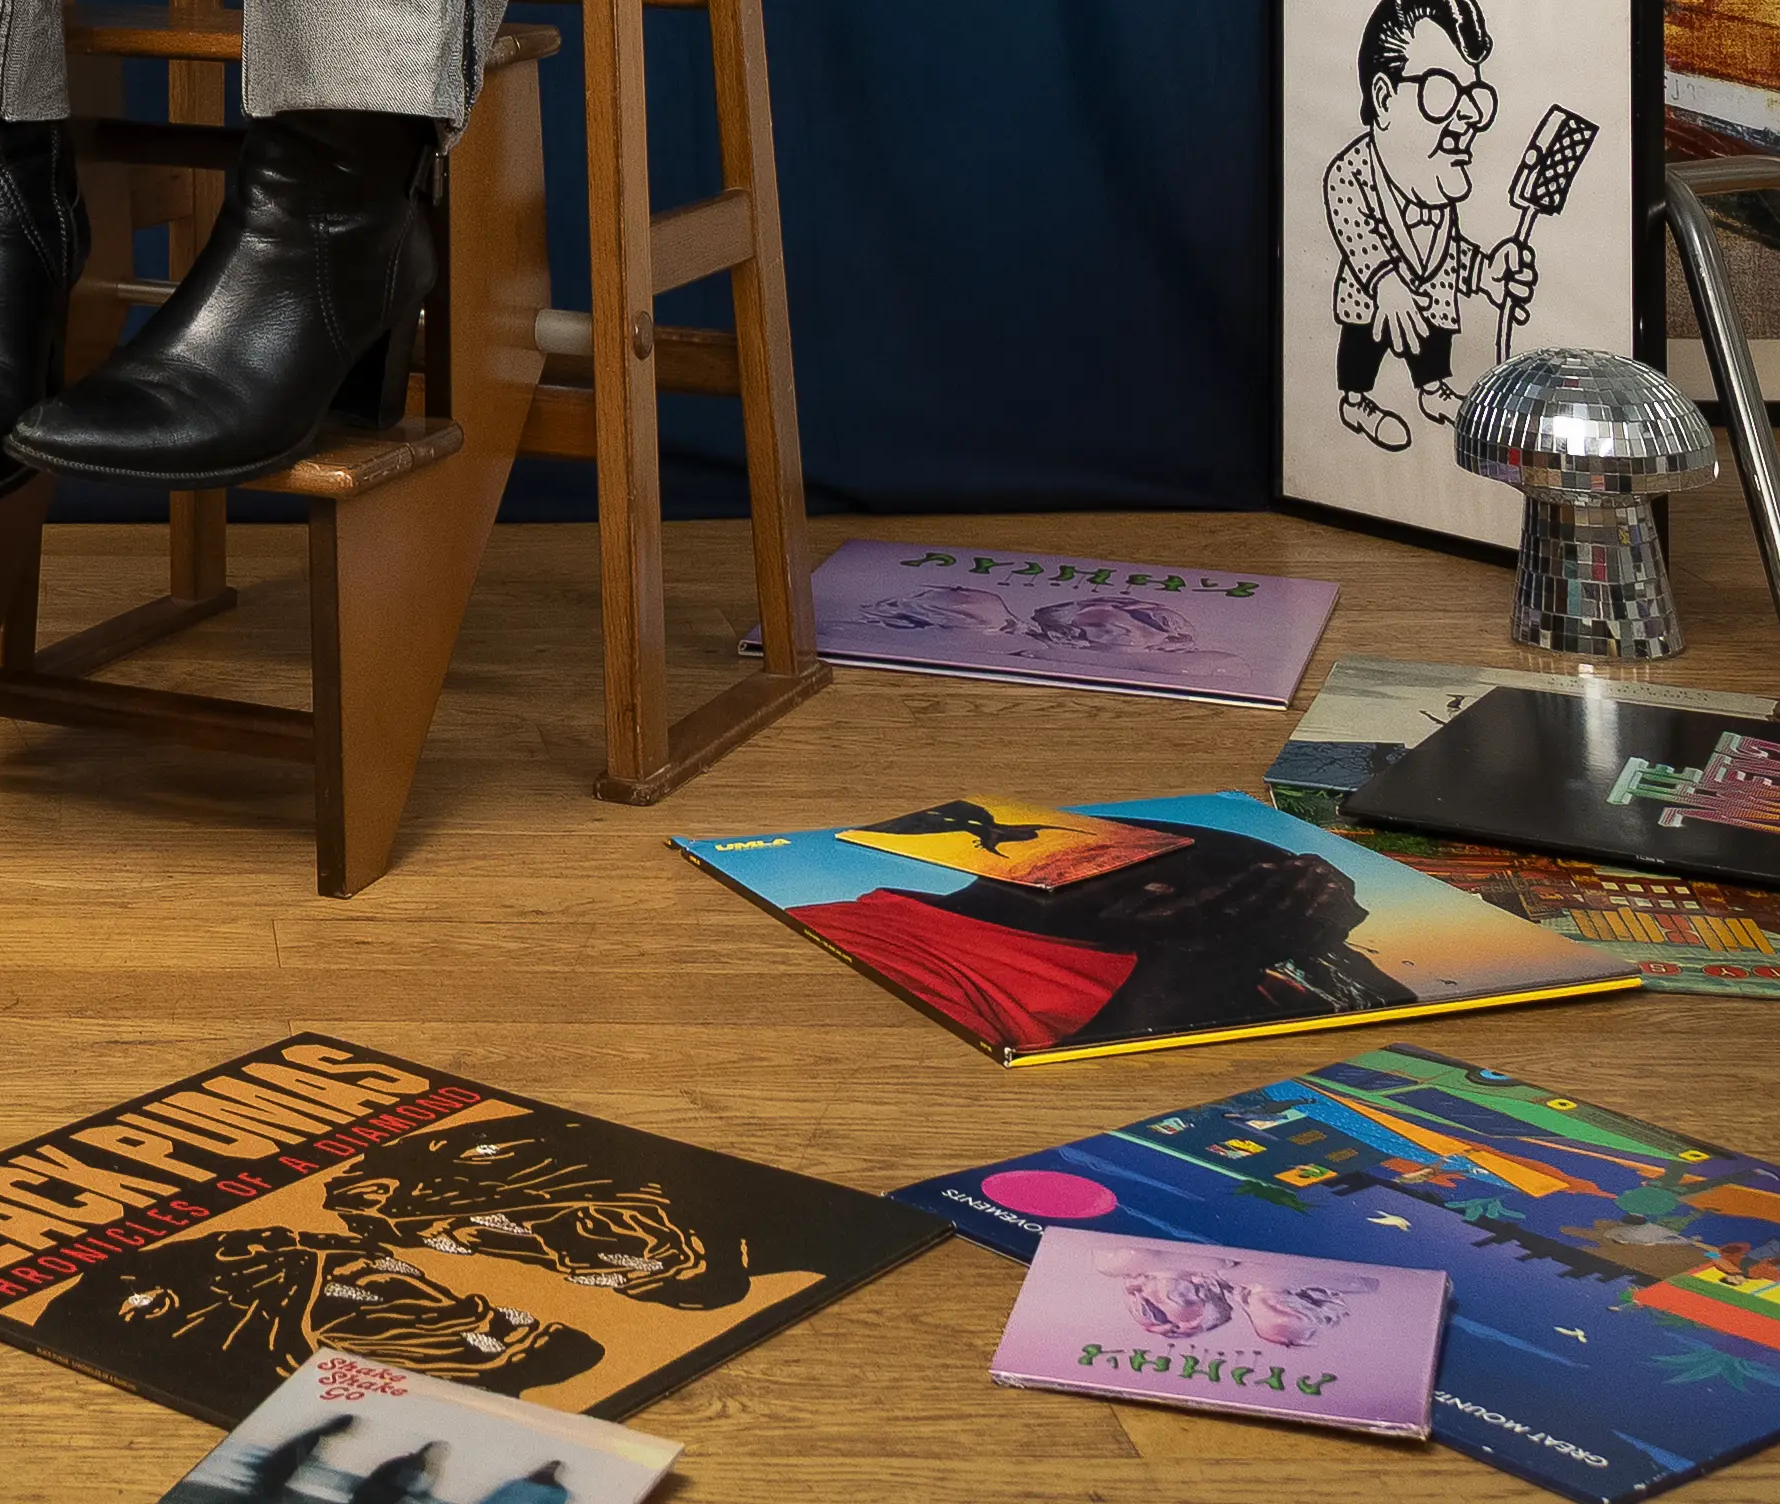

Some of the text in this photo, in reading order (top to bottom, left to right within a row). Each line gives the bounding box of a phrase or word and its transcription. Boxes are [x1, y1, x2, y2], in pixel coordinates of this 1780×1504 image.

[98, 1043, 430, 1198] PUMAS
[217, 1172, 271, 1197] OF
[279, 1156, 318, 1174] A
[314, 1087, 481, 1157] DIAMOND
[941, 1187, 1044, 1235] OVEMENTS
[317, 1357, 407, 1382] Shake
[318, 1371, 408, 1397] Shake
[320, 1386, 365, 1400] Go
[1435, 1391, 1609, 1467] GREAT MOUNT
